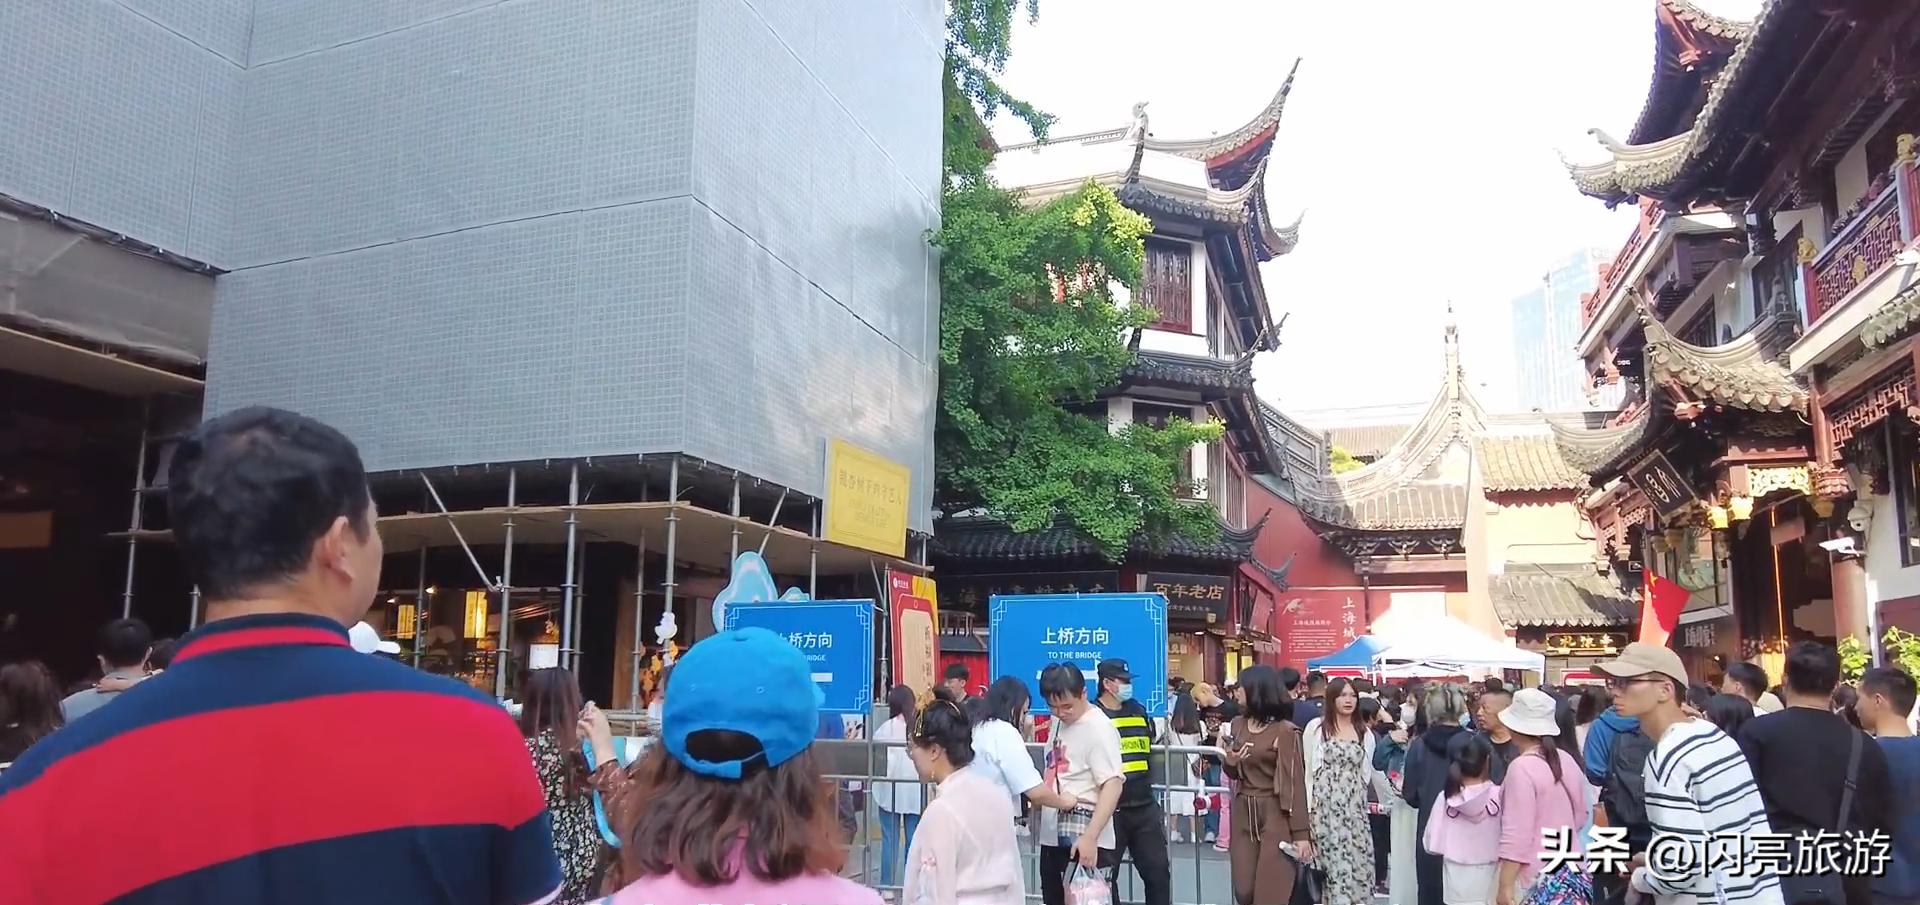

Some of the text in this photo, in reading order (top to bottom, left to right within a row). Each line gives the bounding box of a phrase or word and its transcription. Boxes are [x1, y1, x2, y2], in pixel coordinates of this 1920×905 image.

[1154, 582, 1225, 600] 百年老店
[1040, 627, 1109, 645] 上桥方向
